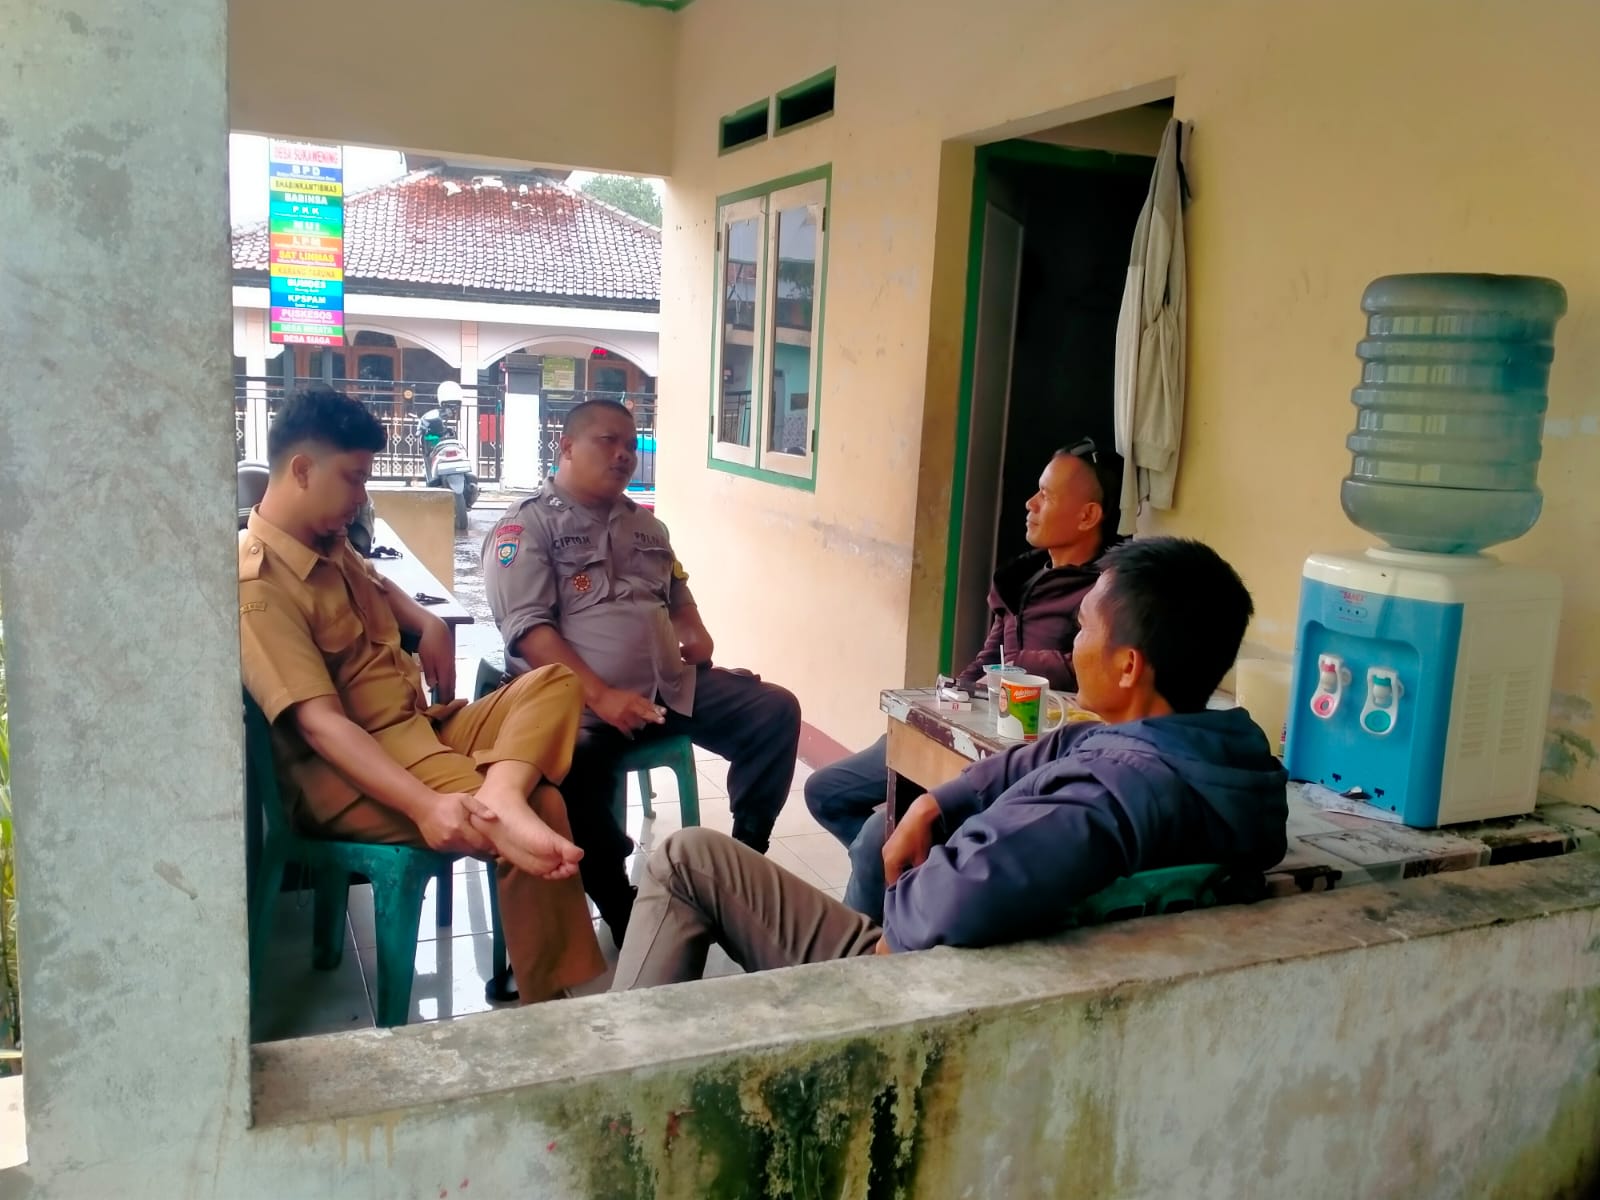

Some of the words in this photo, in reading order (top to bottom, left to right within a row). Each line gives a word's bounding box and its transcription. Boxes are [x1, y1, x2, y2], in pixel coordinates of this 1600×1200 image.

[285, 192, 328, 205] BABINSA
[287, 294, 326, 304] KPSPAM
[281, 308, 333, 320] PUSKESOS
[283, 335, 304, 343] DESA
